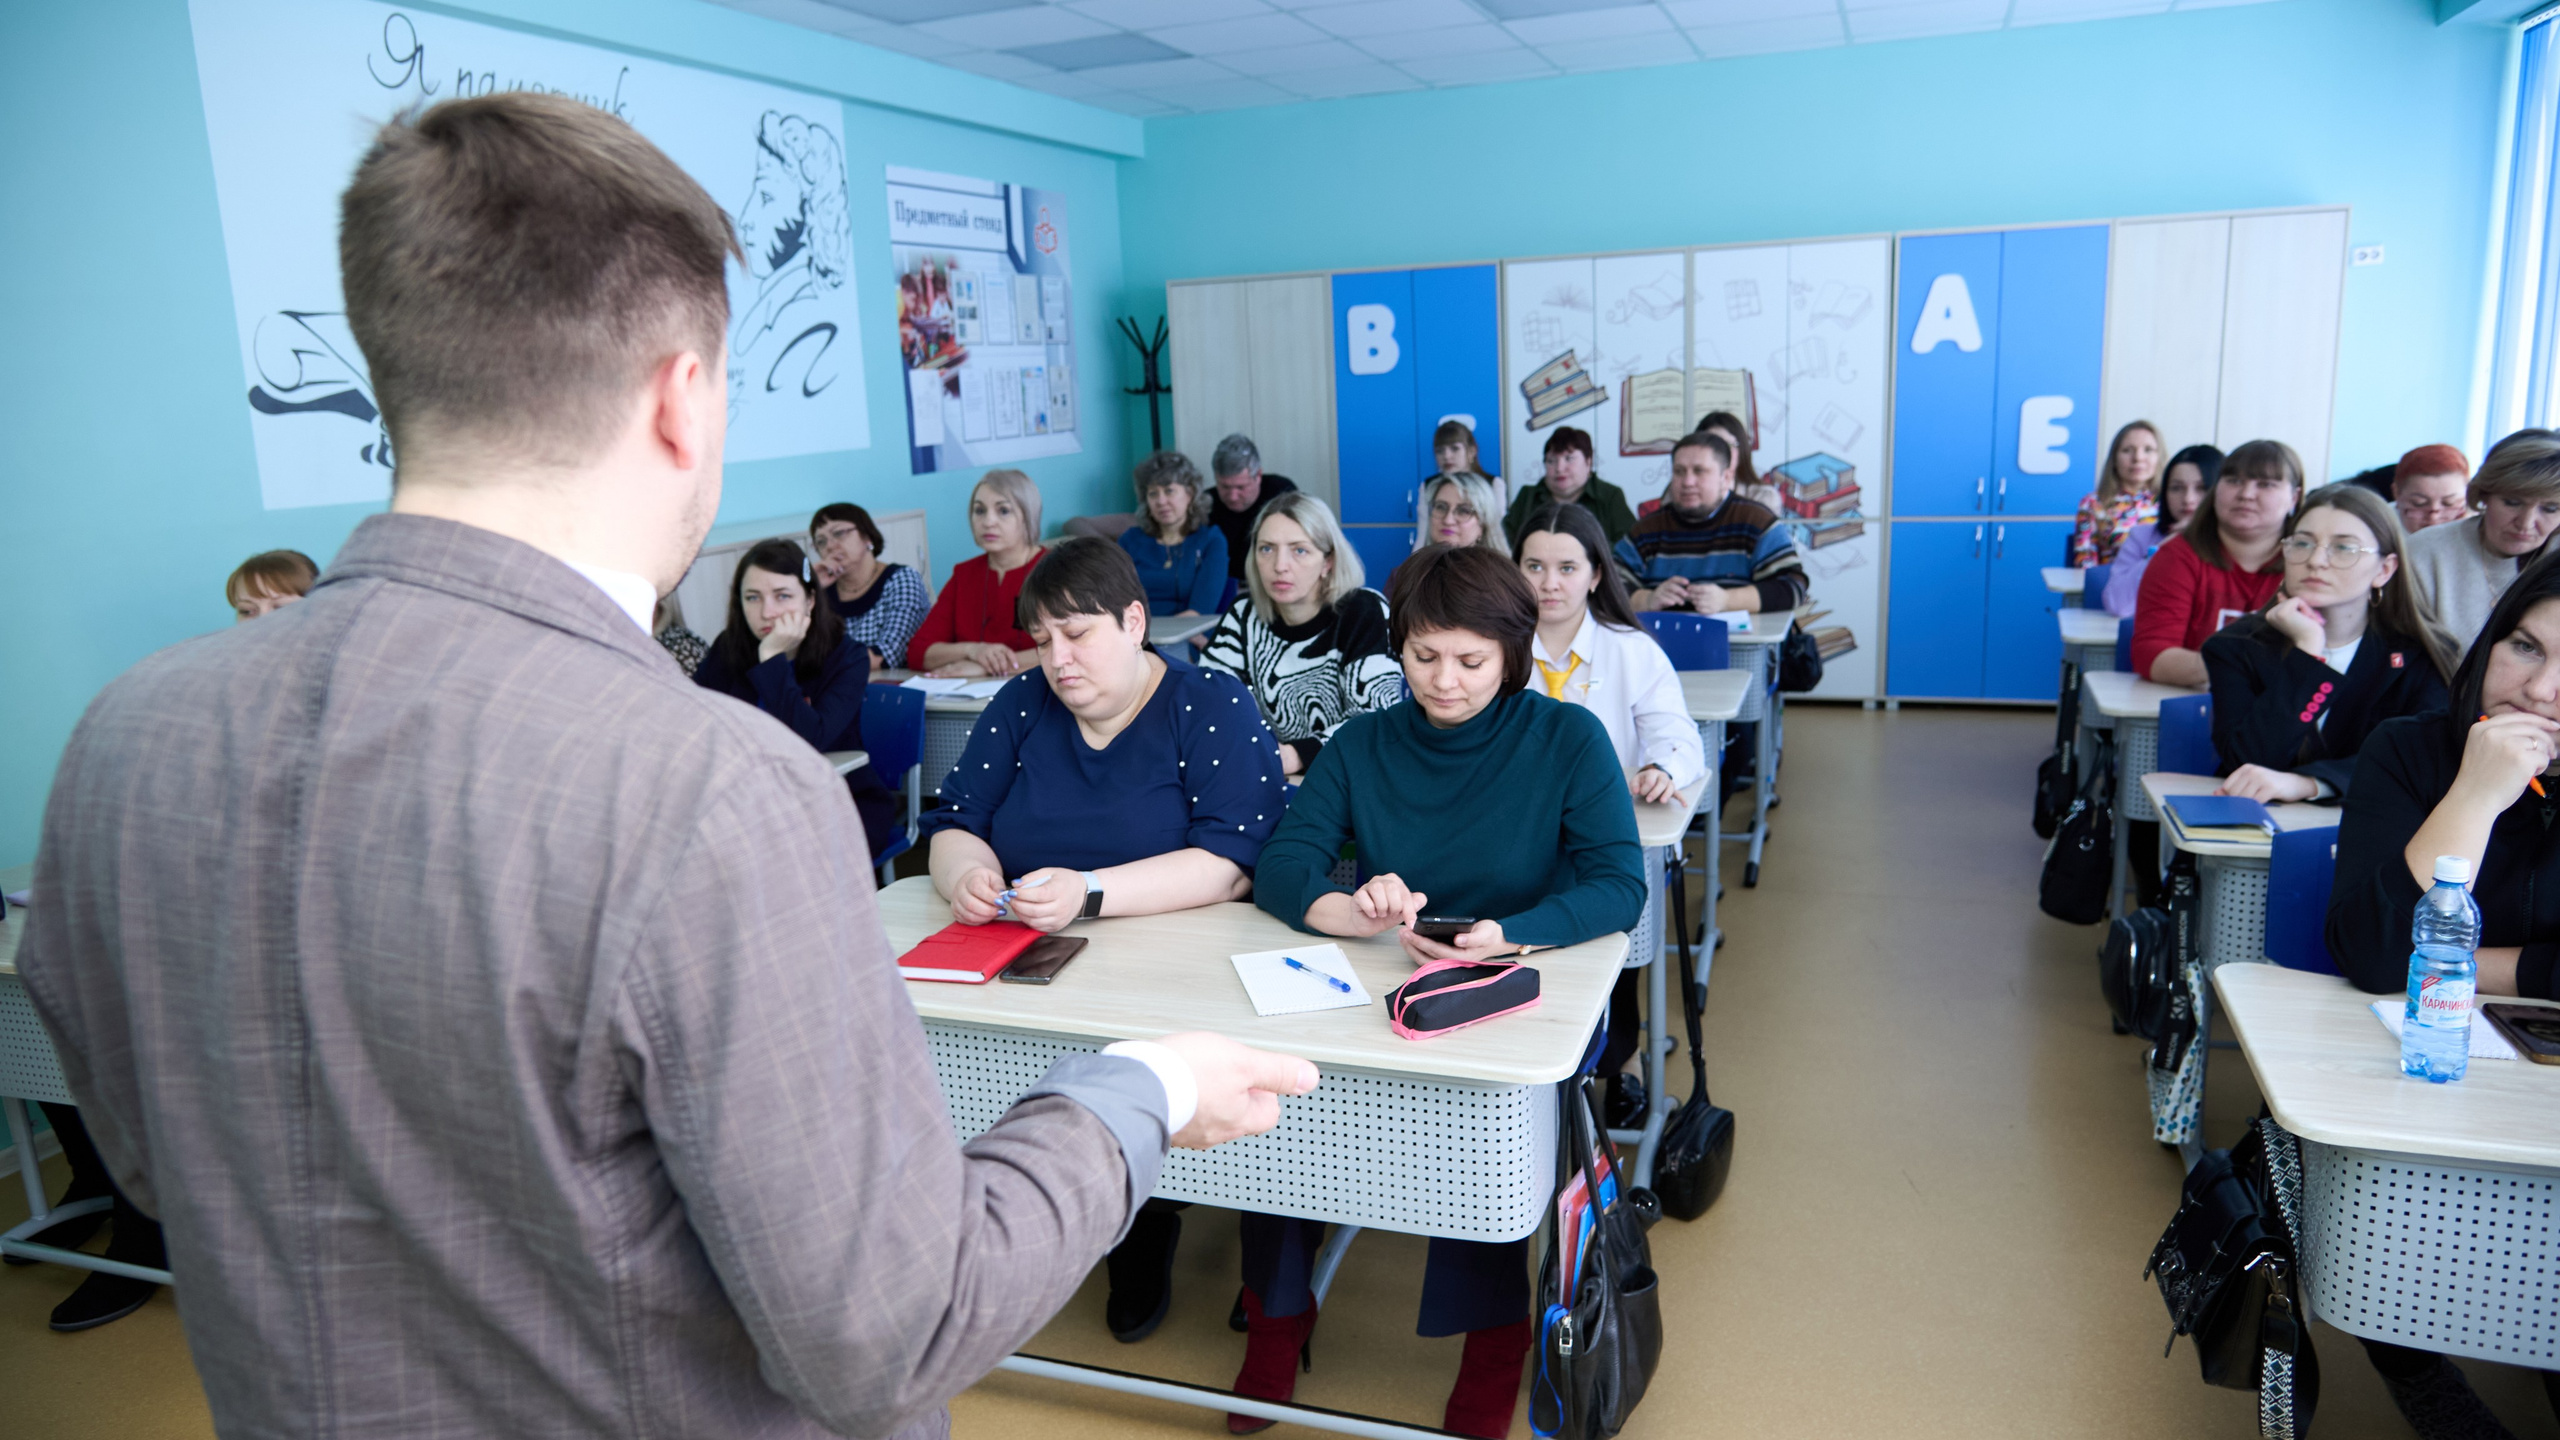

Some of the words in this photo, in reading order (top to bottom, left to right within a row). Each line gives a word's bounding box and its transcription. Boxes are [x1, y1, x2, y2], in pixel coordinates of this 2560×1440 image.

[367, 12, 441, 96] Я
[895, 200, 969, 229] Предметный
[974, 215, 1003, 234] стенд
[1910, 273, 1983, 354] А
